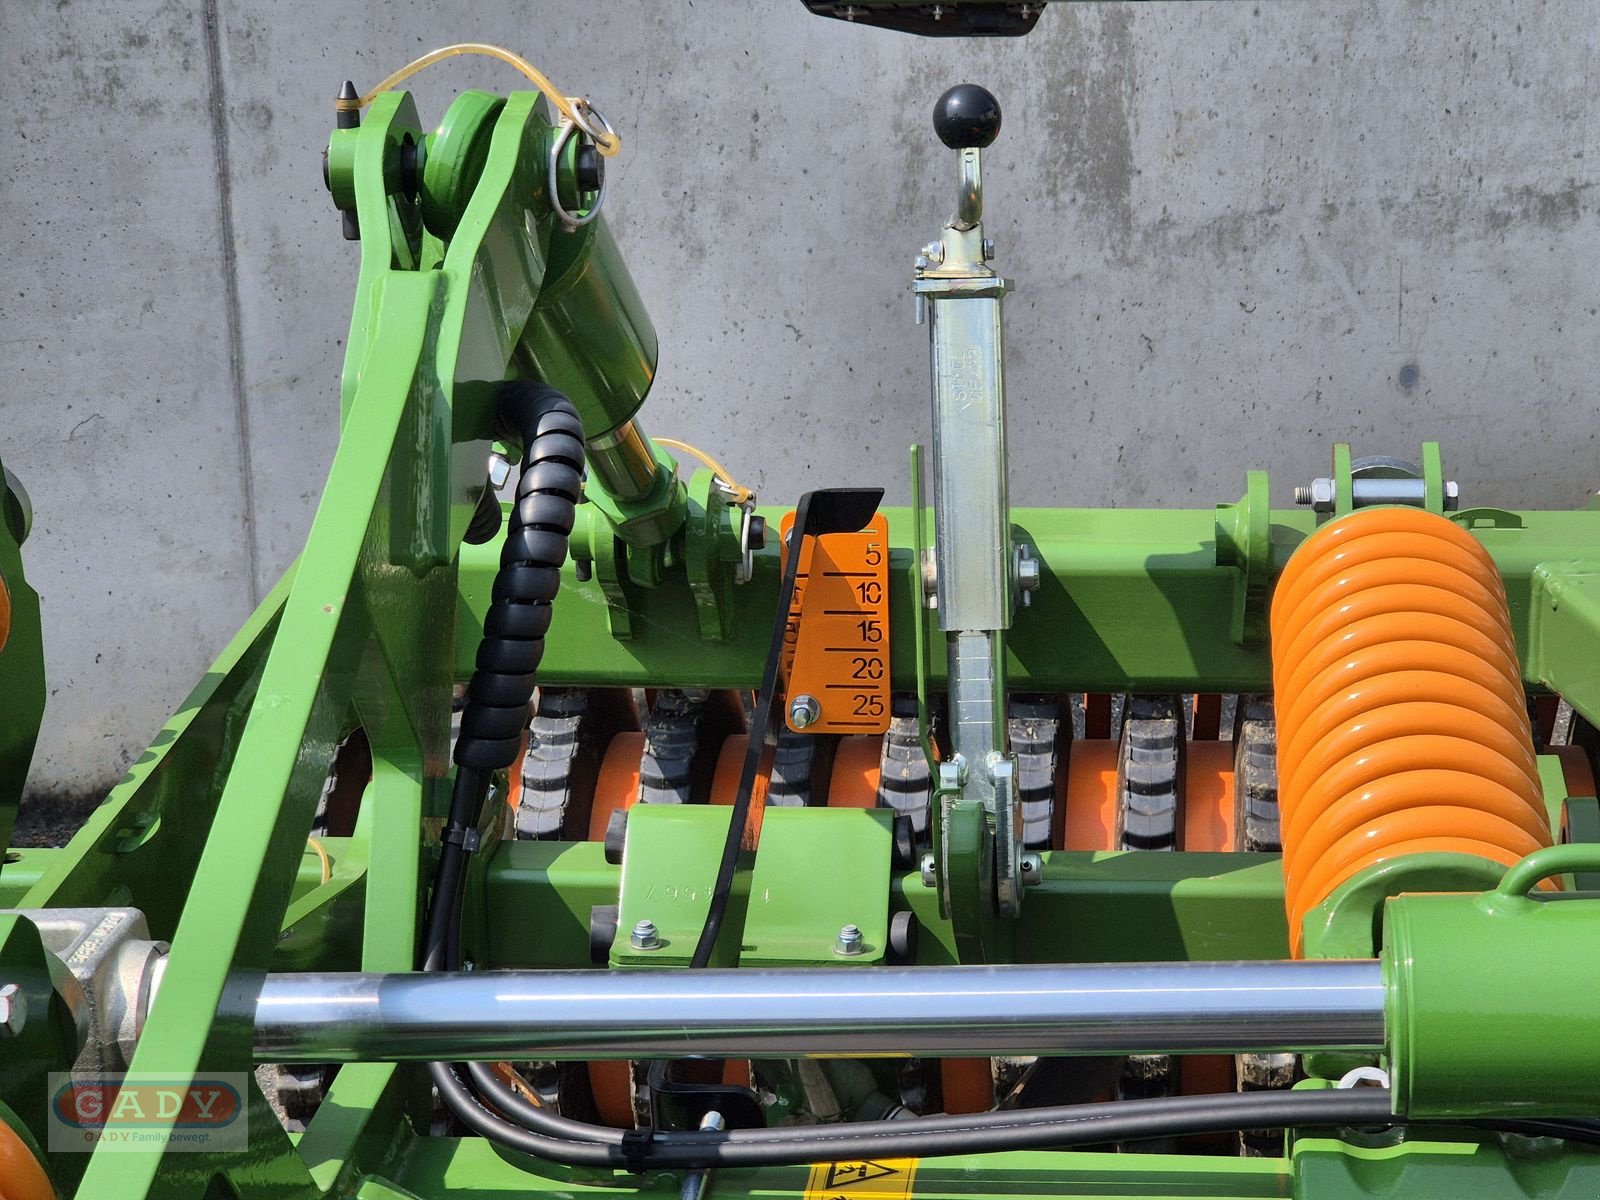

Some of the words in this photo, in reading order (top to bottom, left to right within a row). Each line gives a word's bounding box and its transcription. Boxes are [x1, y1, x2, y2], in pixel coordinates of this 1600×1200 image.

[865, 543, 882, 566] 5
[856, 581, 882, 605] 10
[857, 620, 883, 643] 15
[852, 657, 884, 680] 20
[852, 694, 884, 717] 25
